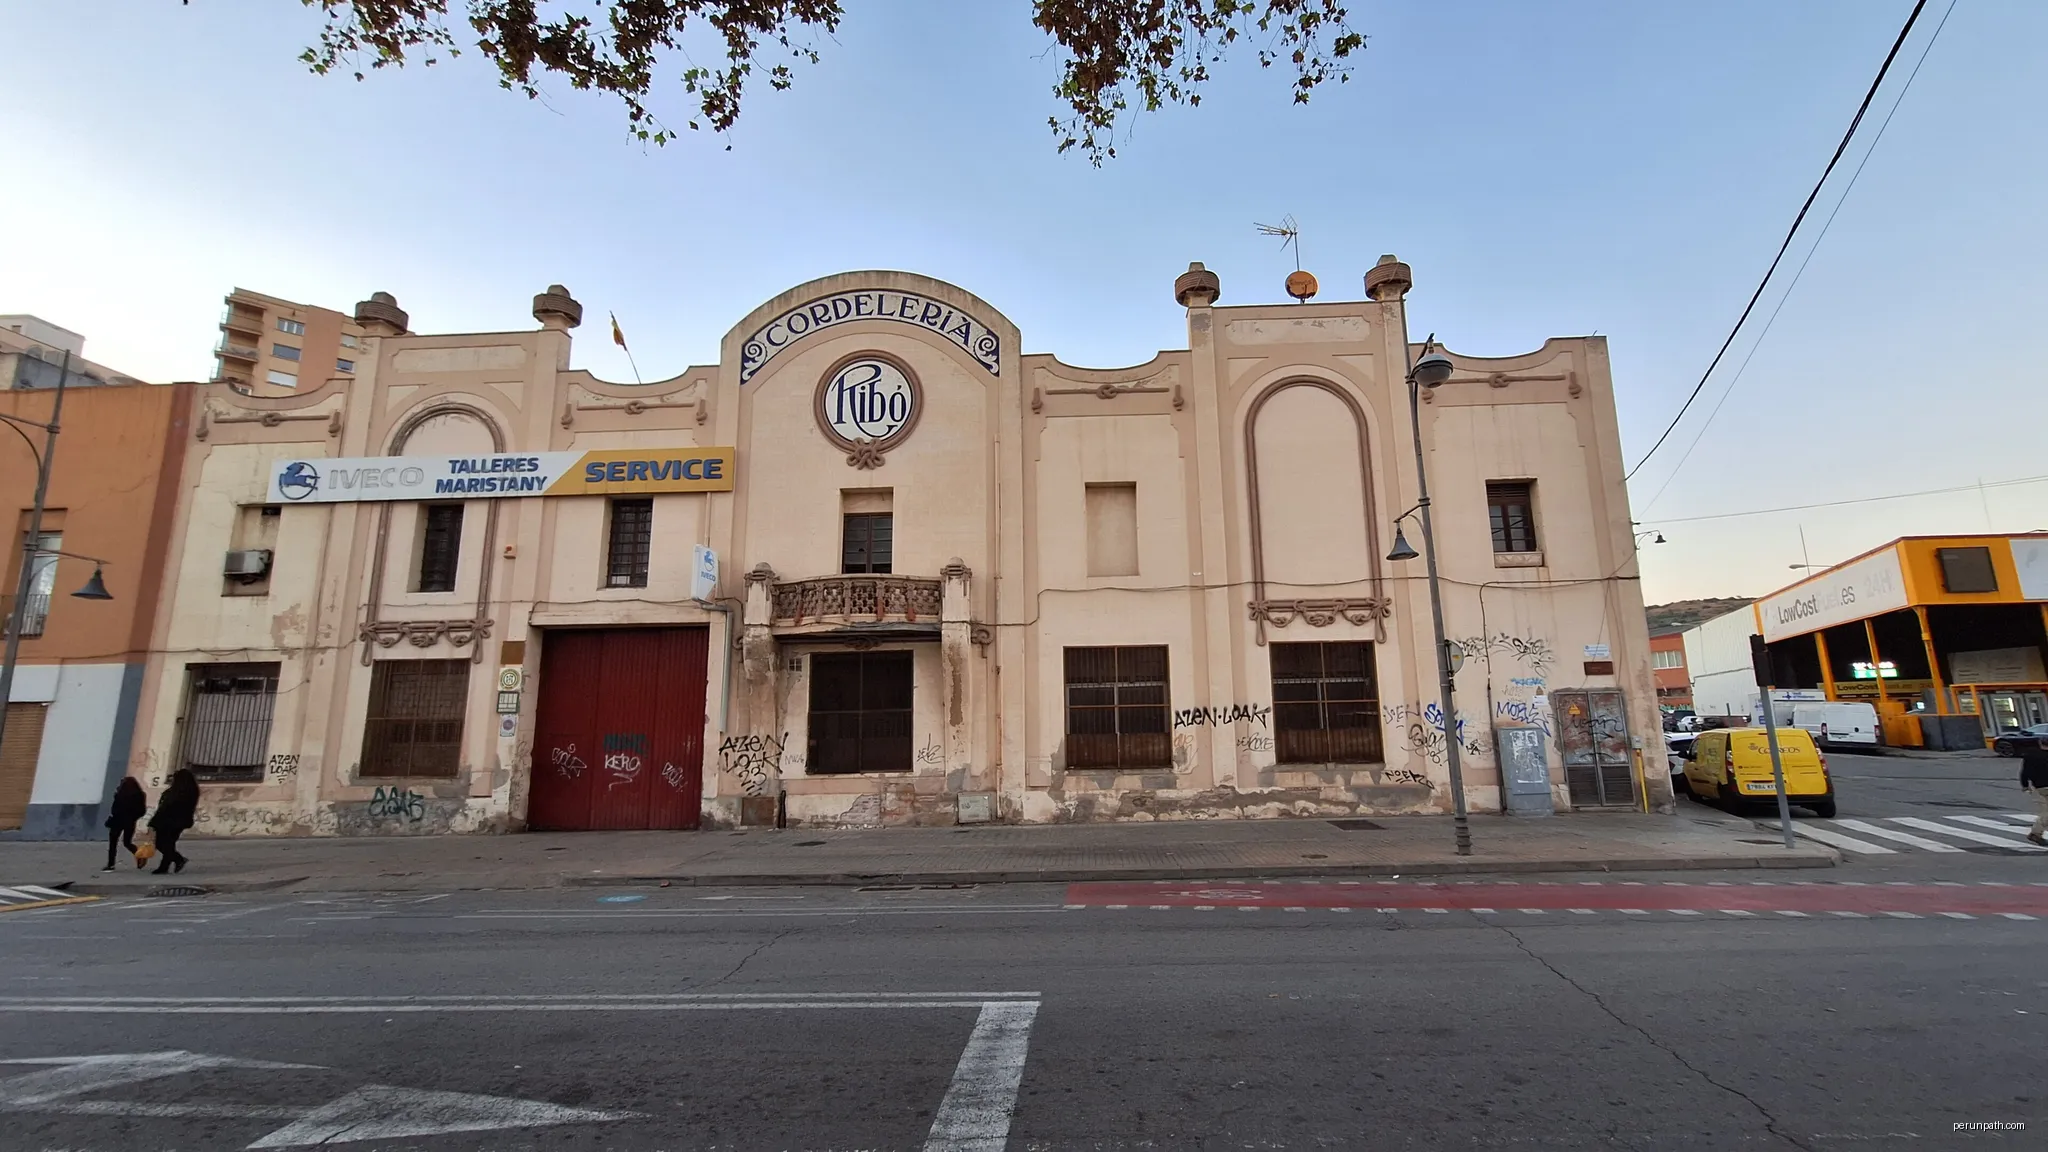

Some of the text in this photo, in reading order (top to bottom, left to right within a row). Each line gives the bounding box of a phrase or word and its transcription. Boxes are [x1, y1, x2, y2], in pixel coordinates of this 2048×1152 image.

[832, 363, 907, 438] Ribó
[449, 457, 540, 474] TALLERES
[585, 458, 724, 483] SERVICE
[328, 466, 425, 490] IVECO
[435, 475, 548, 494] MARISTANY
